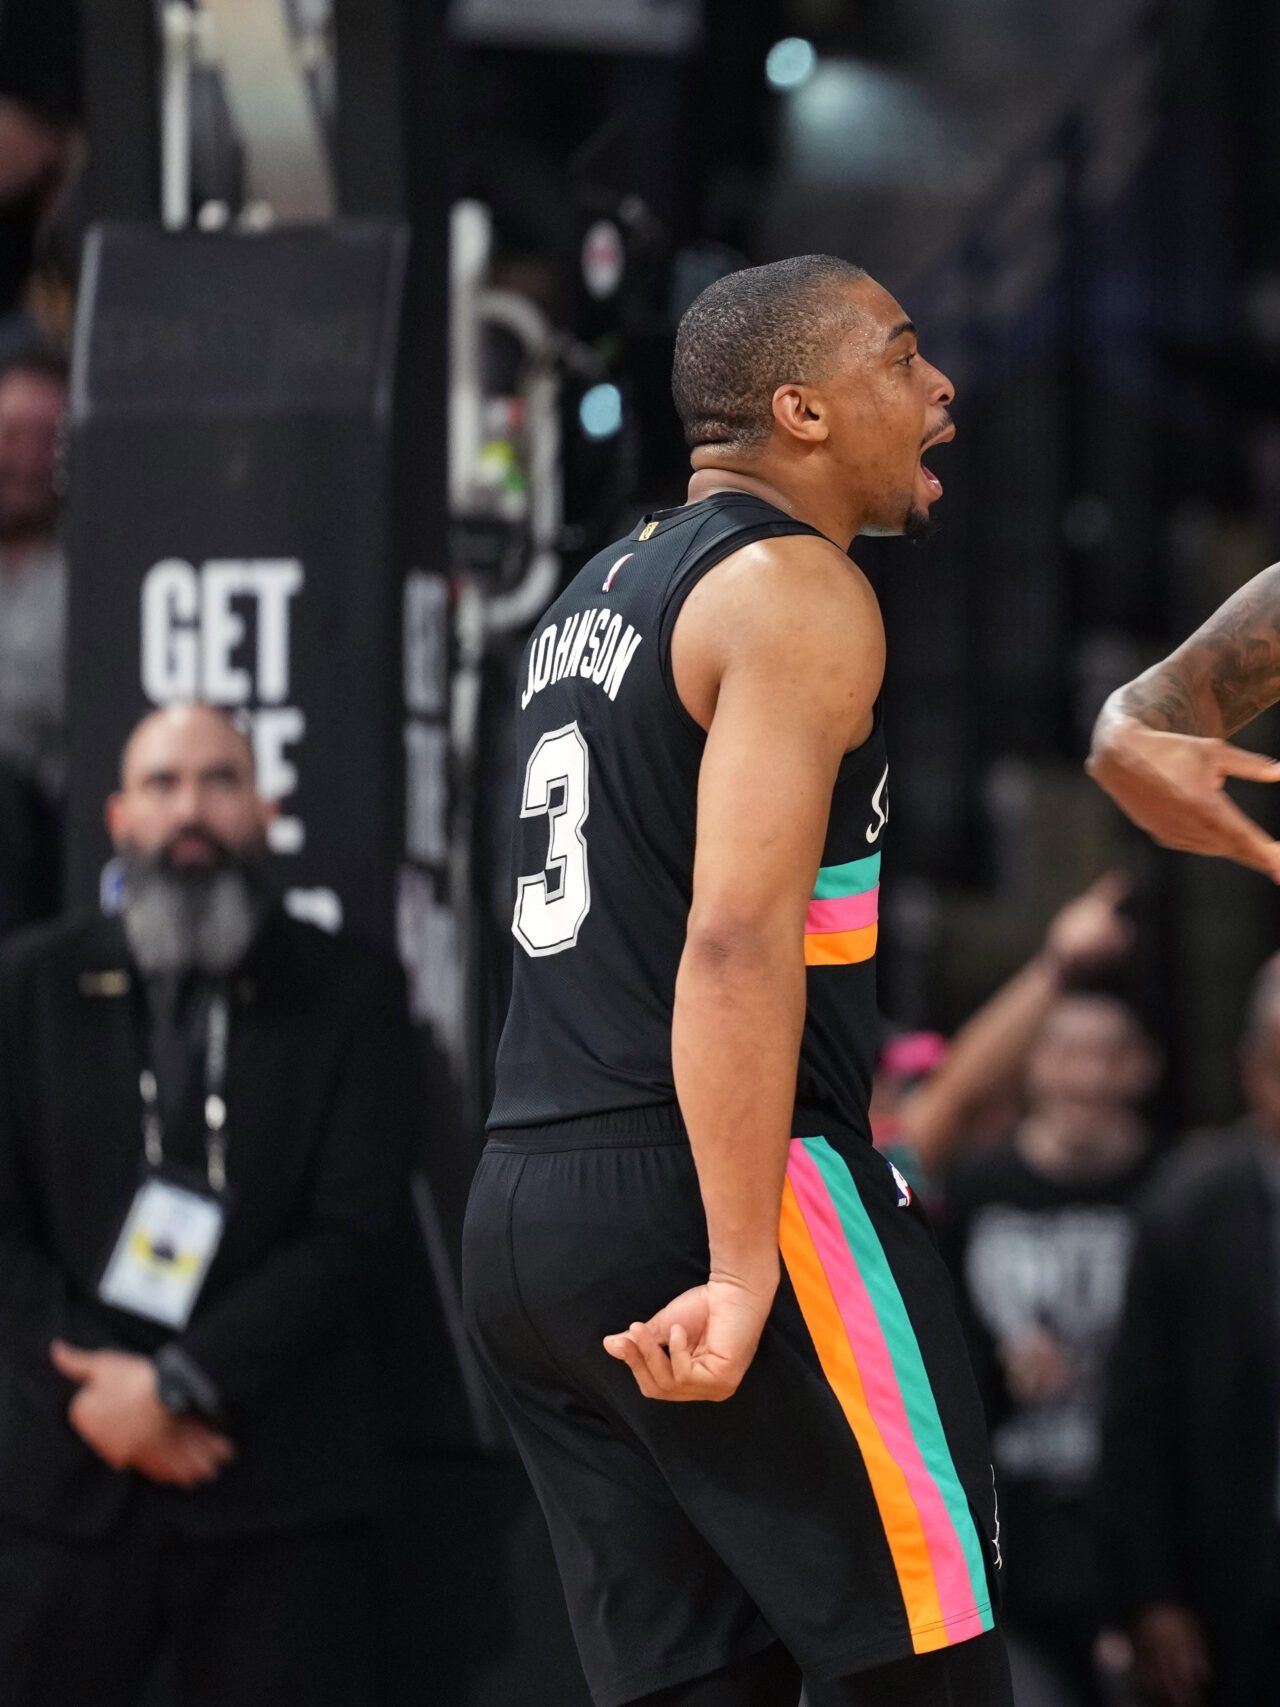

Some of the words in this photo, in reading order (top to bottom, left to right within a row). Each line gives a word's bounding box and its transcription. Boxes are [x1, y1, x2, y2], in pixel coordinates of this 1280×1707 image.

[141, 558, 304, 705] GET
[521, 608, 642, 711] JOHNSON
[511, 720, 591, 958] 3
